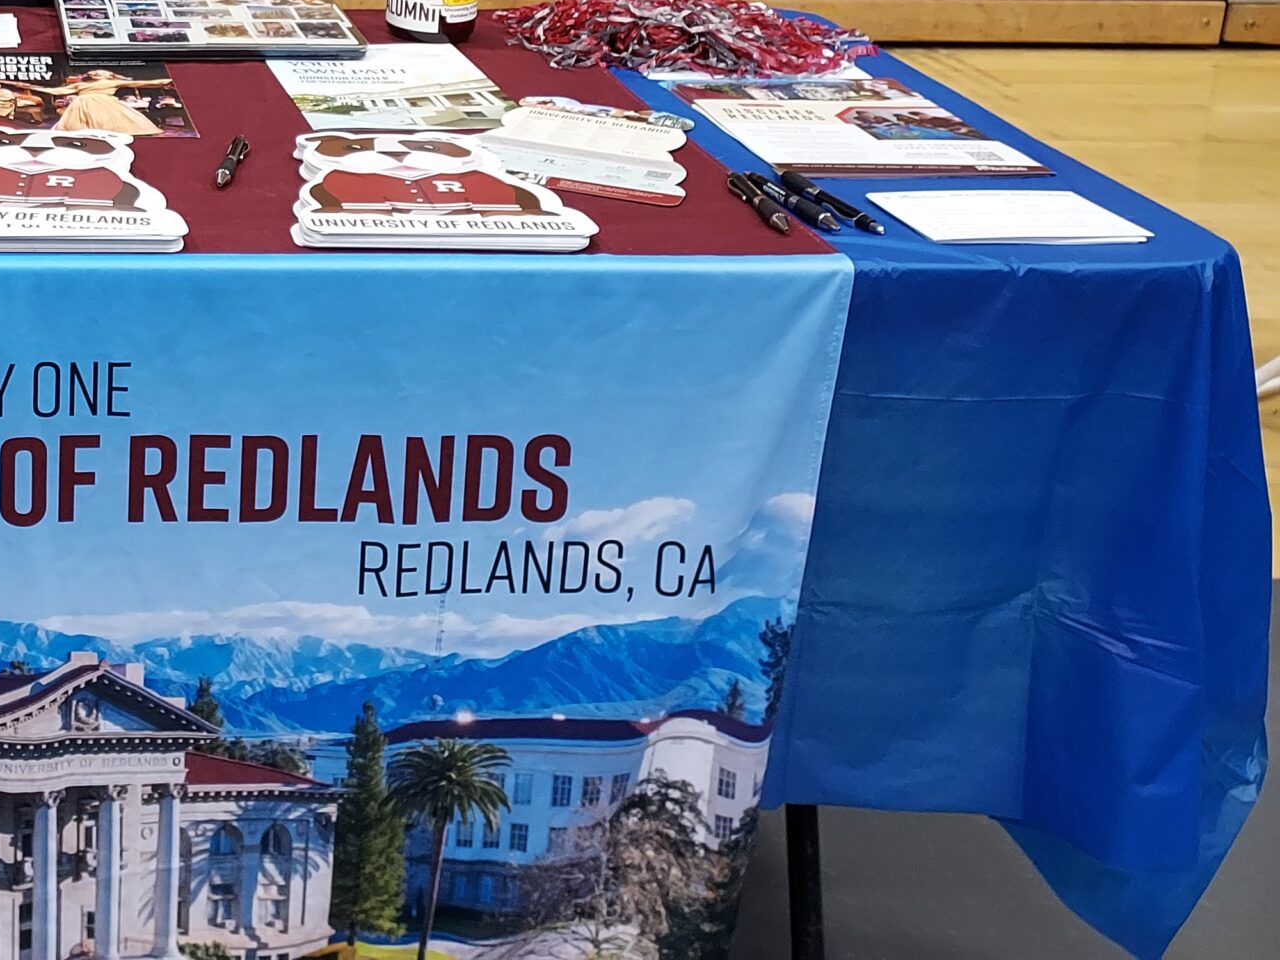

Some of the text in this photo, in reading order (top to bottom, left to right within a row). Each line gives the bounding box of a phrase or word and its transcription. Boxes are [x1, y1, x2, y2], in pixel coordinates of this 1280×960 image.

[722, 107, 815, 115] DISCOVER
[727, 113, 826, 121] REDLANDS
[528, 109, 592, 124] UNIVERSITY
[611, 120, 672, 134] REDLANDS
[45, 175, 76, 188] R
[432, 180, 465, 192] R
[15, 211, 40, 221] OF
[46, 213, 152, 226] REDLANDS
[311, 218, 576, 232] UNIVERSITY OF REDLANDS
[31, 359, 132, 418] ONE
[126, 433, 573, 525] REDLANDS
[358, 538, 718, 602] REDLANDS, CA
[79, 757, 93, 768] OF
[101, 756, 168, 769] REDLANDS
